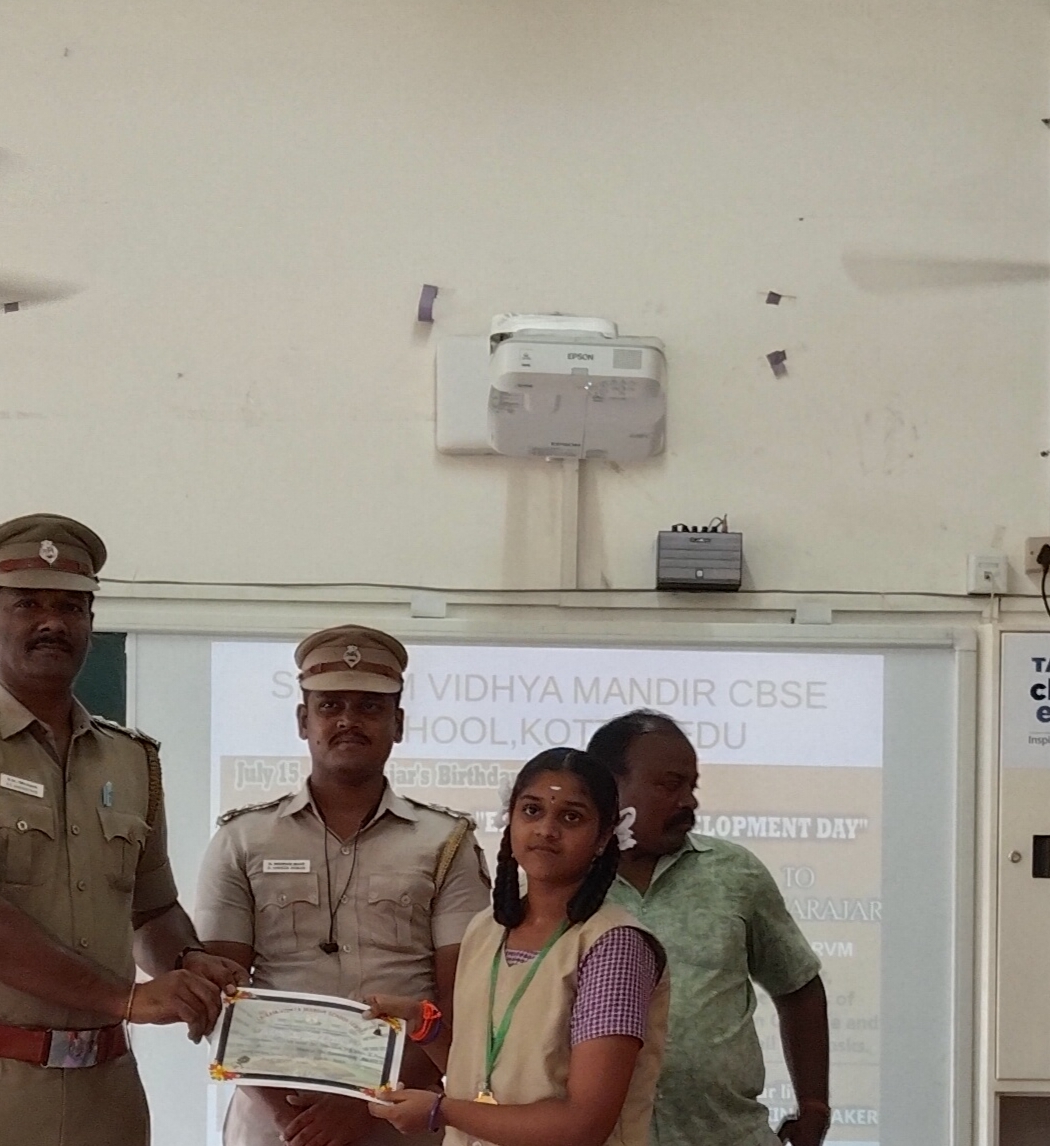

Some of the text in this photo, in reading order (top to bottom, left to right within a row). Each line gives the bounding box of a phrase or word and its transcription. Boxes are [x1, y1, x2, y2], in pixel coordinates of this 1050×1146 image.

[567, 352, 594, 361] EPSON
[427, 672, 563, 704] VIDHYA
[573, 676, 717, 707] MANDIR
[729, 679, 828, 710] CBSE
[235, 760, 275, 791] July
[783, 866, 815, 888] TO
[791, 899, 882, 921] ARAJAR
[831, 1108, 879, 1125] AKER
